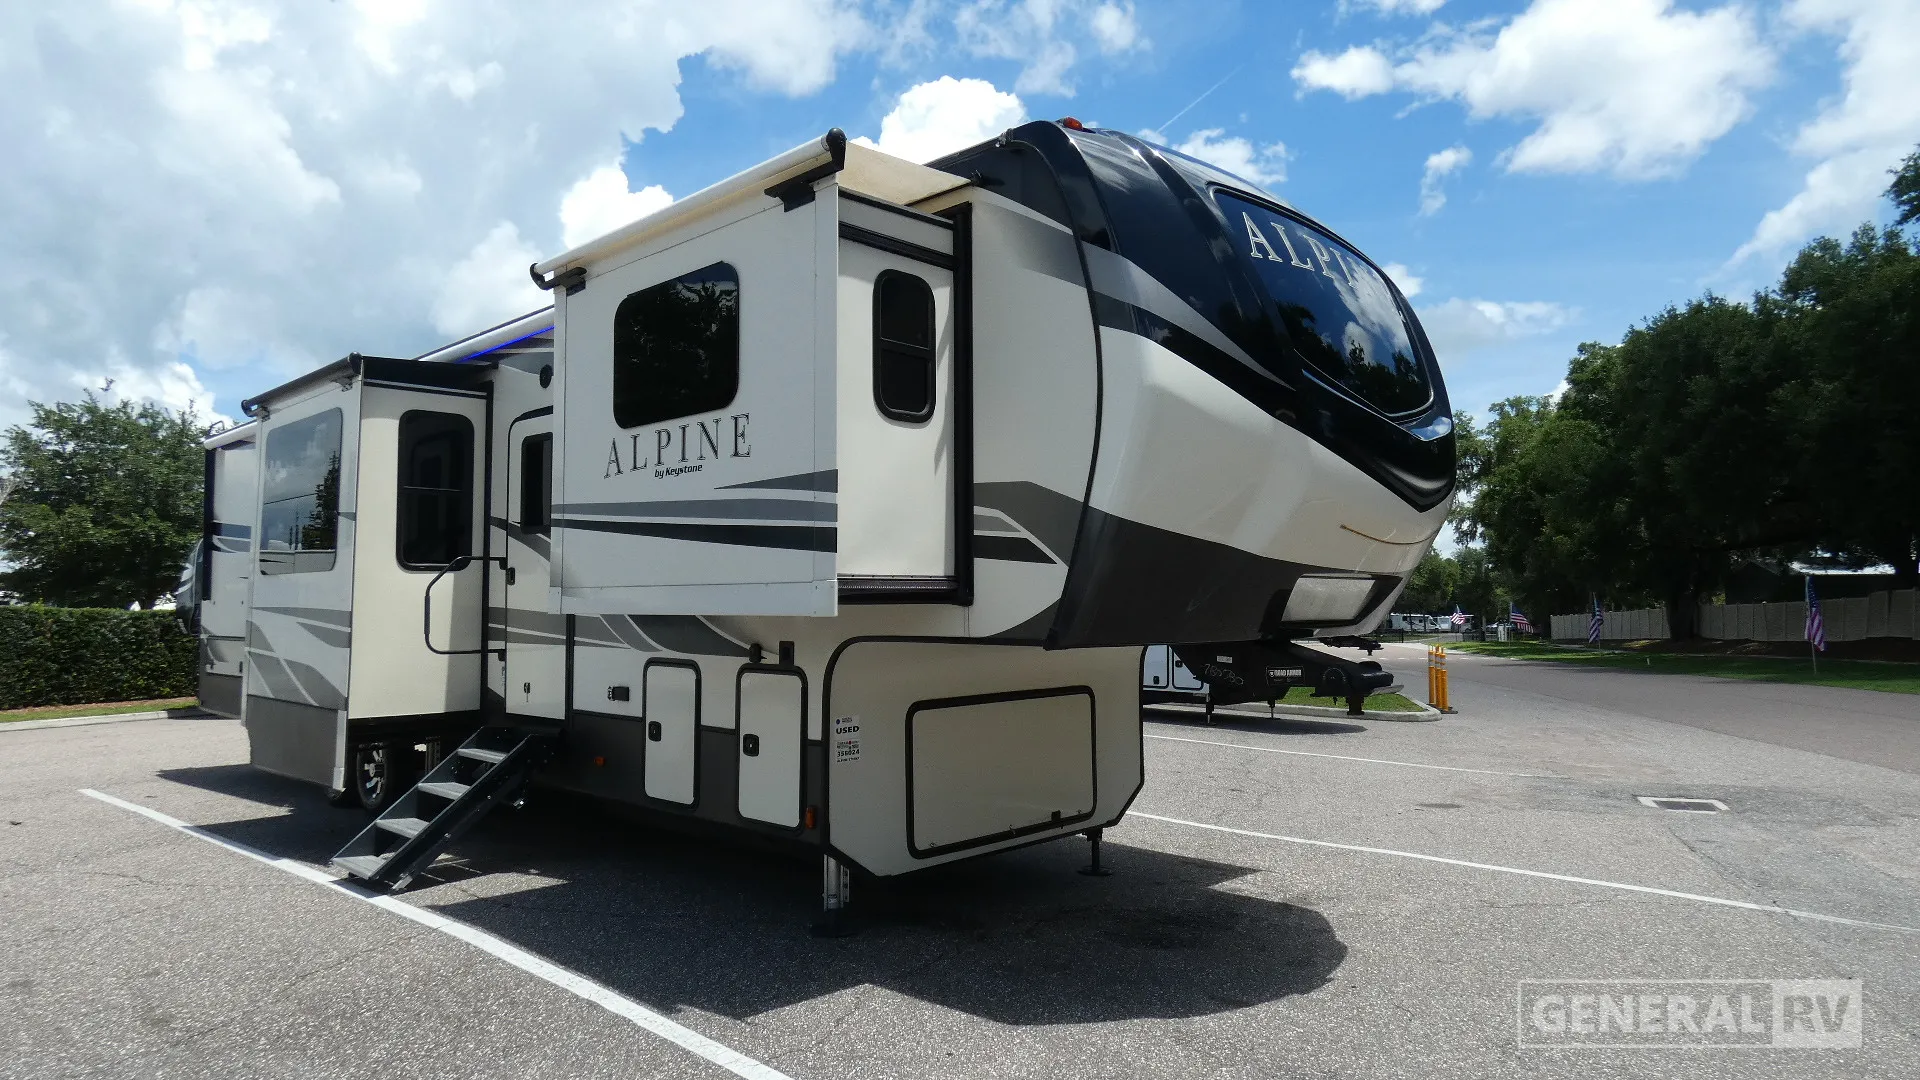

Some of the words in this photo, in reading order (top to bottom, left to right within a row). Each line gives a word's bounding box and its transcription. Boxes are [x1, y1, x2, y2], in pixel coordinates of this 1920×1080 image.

[604, 413, 751, 479] ALPINE
[654, 468, 665, 479] by
[665, 464, 703, 477] Keystone
[836, 725, 860, 734] USED
